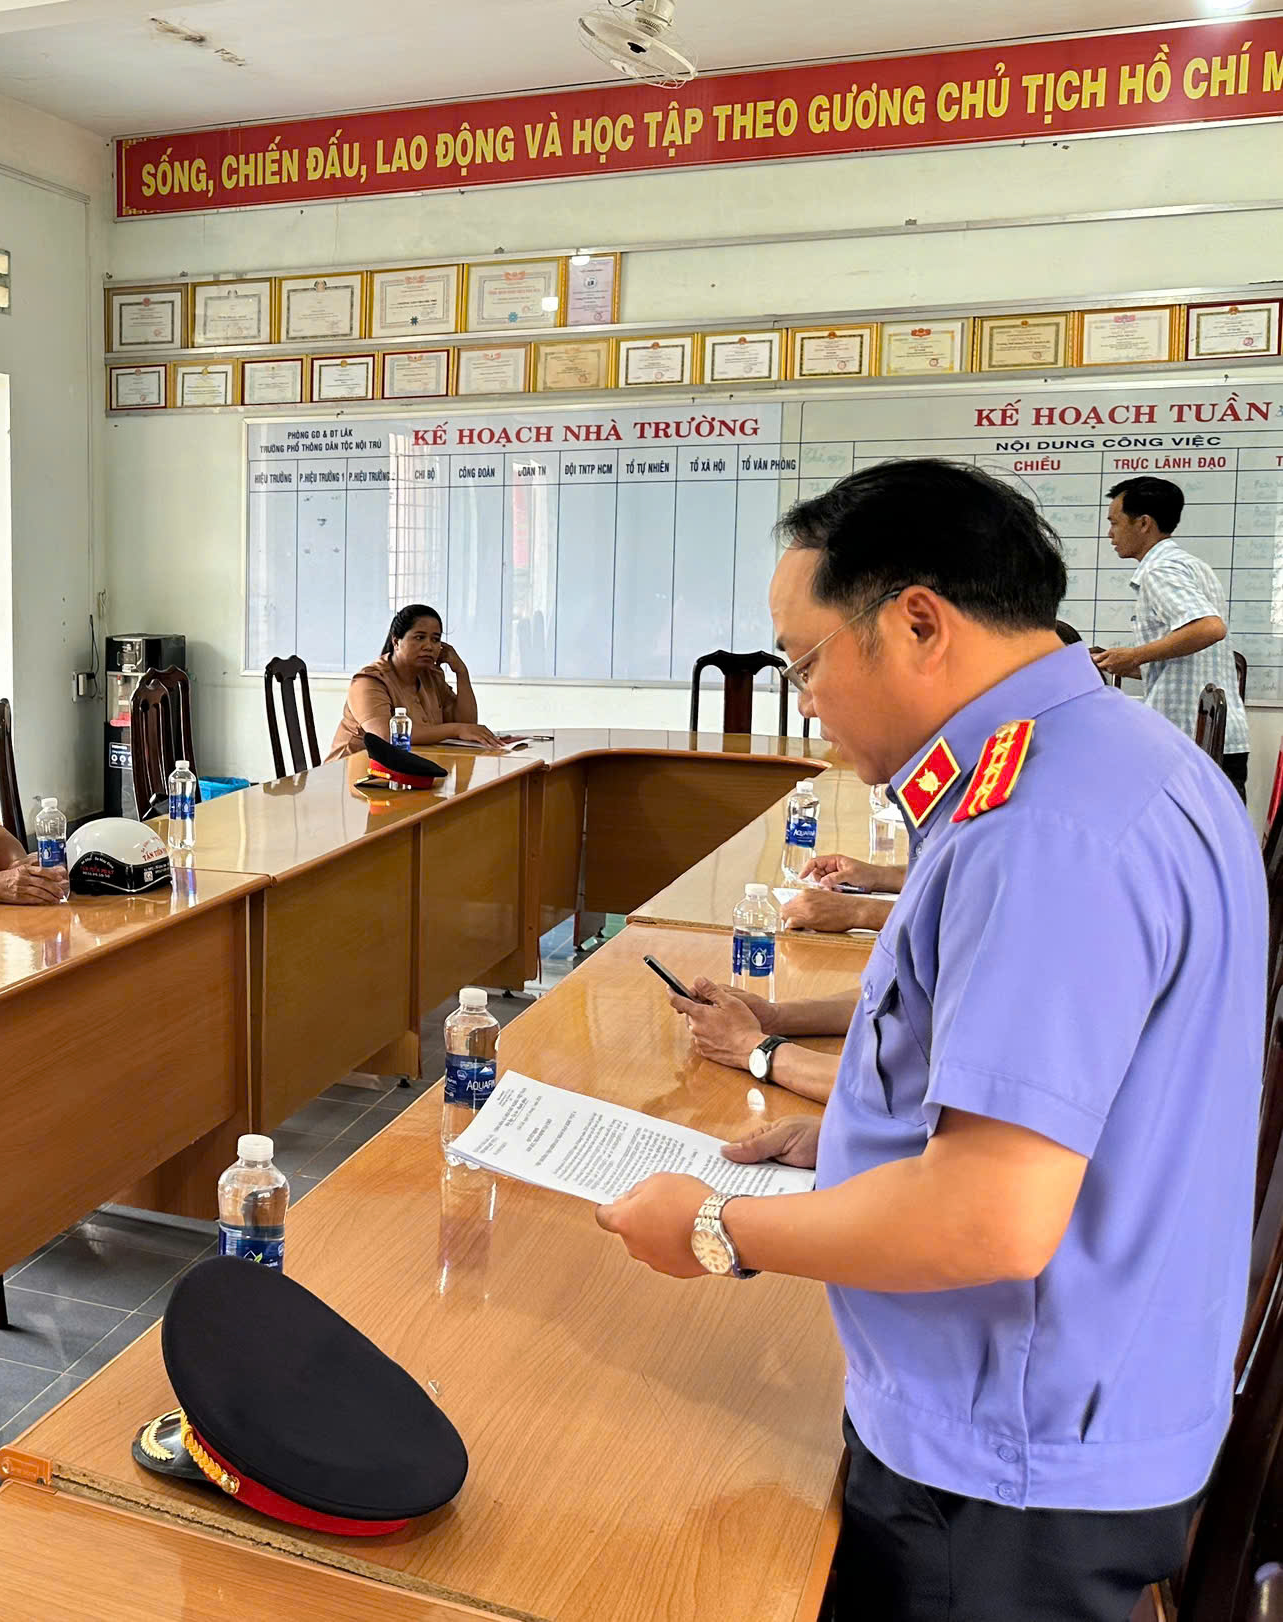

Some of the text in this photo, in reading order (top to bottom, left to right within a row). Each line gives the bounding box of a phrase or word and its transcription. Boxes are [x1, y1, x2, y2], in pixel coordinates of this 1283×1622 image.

[142, 148, 214, 197] SỐNG,
[221, 135, 299, 189] CHIẾN
[306, 129, 367, 182] ĐẤU,
[376, 136, 428, 174] LAO
[435, 122, 515, 176] ĐỘNG
[524, 111, 563, 159] VÀ
[572, 115, 635, 164] HỌC
[644, 100, 704, 157] TẬP
[712, 98, 798, 142] THEO
[808, 82, 926, 134] GƯƠNG
[936, 63, 1010, 123] CHỦ
[1021, 68, 1107, 125] TỊCH
[1118, 44, 1172, 105] HỒ
[1182, 41, 1252, 100] CHÍ
[974, 399, 1021, 427] KẾ
[1032, 404, 1158, 429] HOẠCH
[1169, 392, 1273, 423] TUẦN
[412, 415, 760, 447] KẾ HOẠCH NHÀ TRƯỜNG
[996, 435, 1221, 452] NỘI DUNG CÔNG VIỆC
[578, 464, 596, 476] TNTP
[597, 463, 613, 475] HCM
[647, 460, 670, 473] NHIÊN
[770, 456, 796, 471] PHÒNG
[1013, 455, 1227, 472] CHIỀU TRỰC LÃNH ĐẠO
[459, 466, 476, 479] CÔNG
